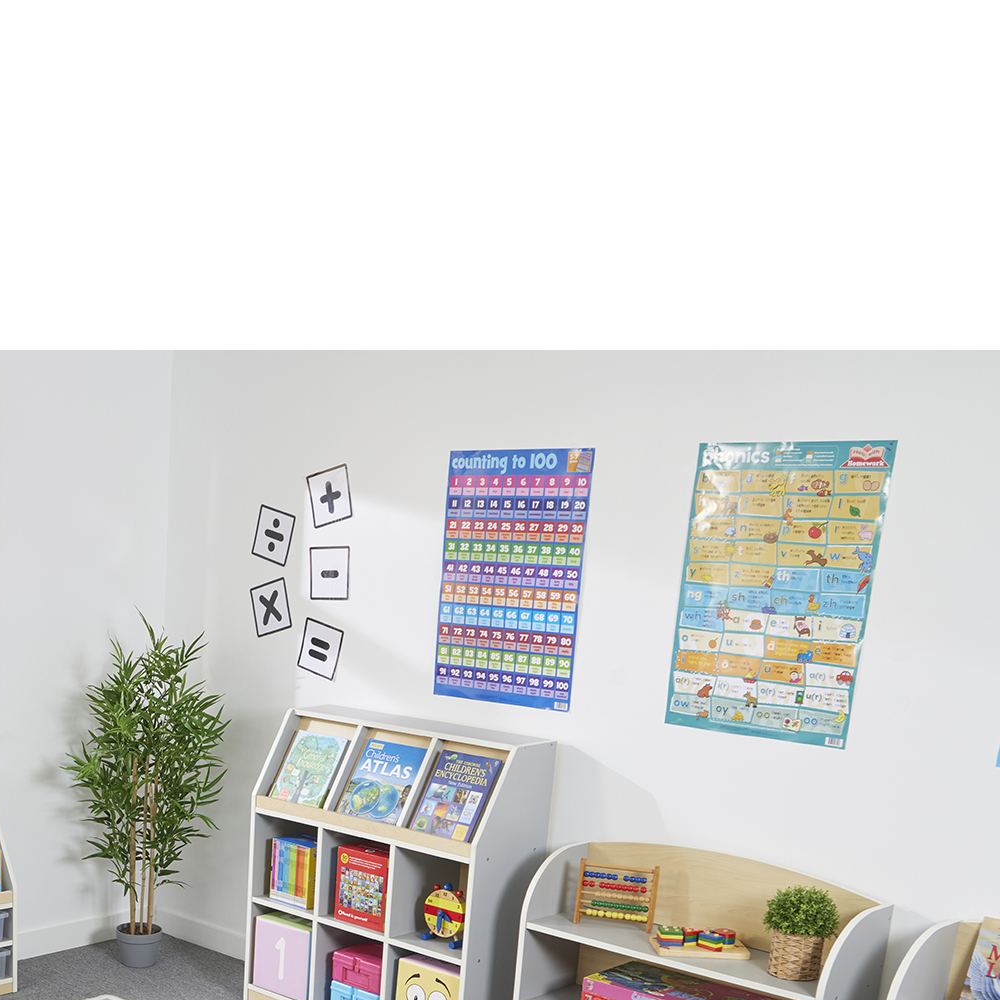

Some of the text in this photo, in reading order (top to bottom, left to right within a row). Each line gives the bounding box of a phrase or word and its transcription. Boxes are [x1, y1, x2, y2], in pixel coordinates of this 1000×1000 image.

[452, 453, 558, 474] counting to 100
[507, 478, 512, 486] 5
[549, 478, 555, 486] 8
[578, 478, 586, 486] 10
[776, 570, 839, 584] th th
[687, 589, 837, 609] ng sh ch zh
[685, 611, 702, 621] wh
[503, 675, 512, 683] 96
[529, 678, 539, 686] 98
[556, 682, 568, 690] 100
[716, 704, 729, 715] oy
[366, 749, 400, 763] Children's
[360, 758, 413, 780] ATLAS
[444, 762, 486, 777] CHILDREN'S
[434, 769, 488, 786] ENCYCLOPEDIA
[275, 936, 286, 981] 1
